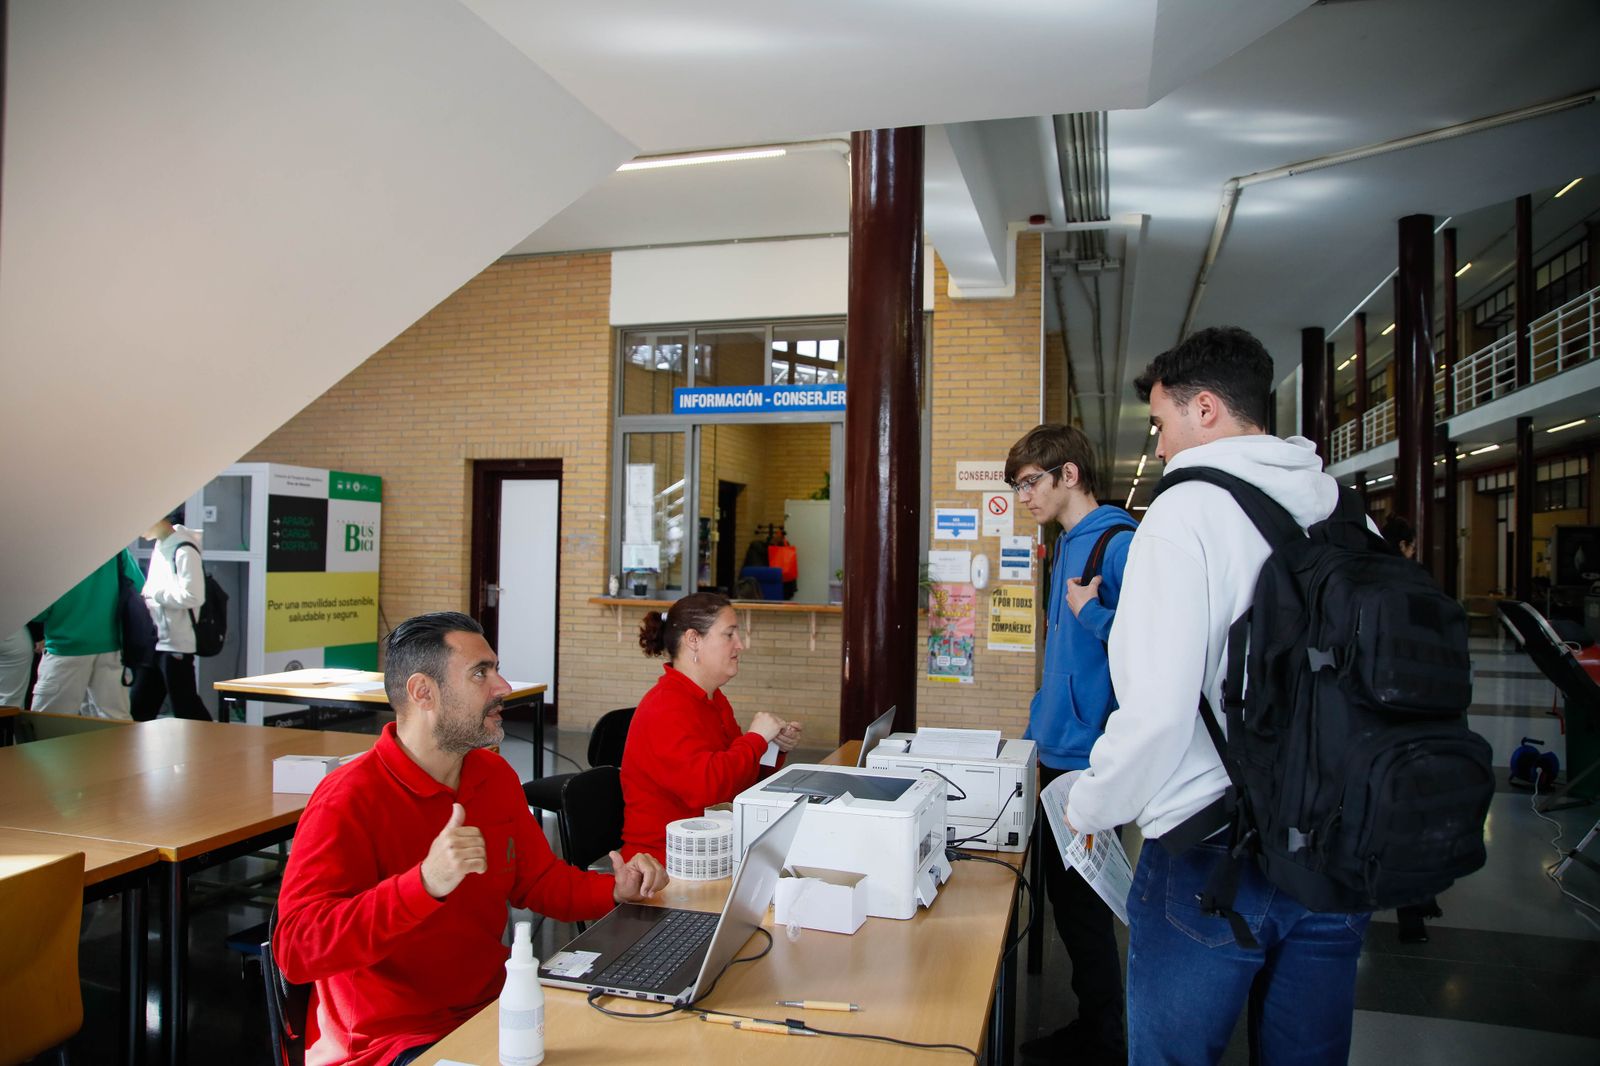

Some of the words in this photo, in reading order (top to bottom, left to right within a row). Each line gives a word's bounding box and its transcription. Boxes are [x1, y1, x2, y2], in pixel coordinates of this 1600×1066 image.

[680, 390, 763, 408] INFORMACIÓN
[267, 600, 283, 610] Por
[285, 602, 300, 610] una
[301, 598, 337, 609] movilidad
[998, 597, 1011, 608] POR
[289, 612, 325, 622] saludable
[327, 613, 333, 622] y
